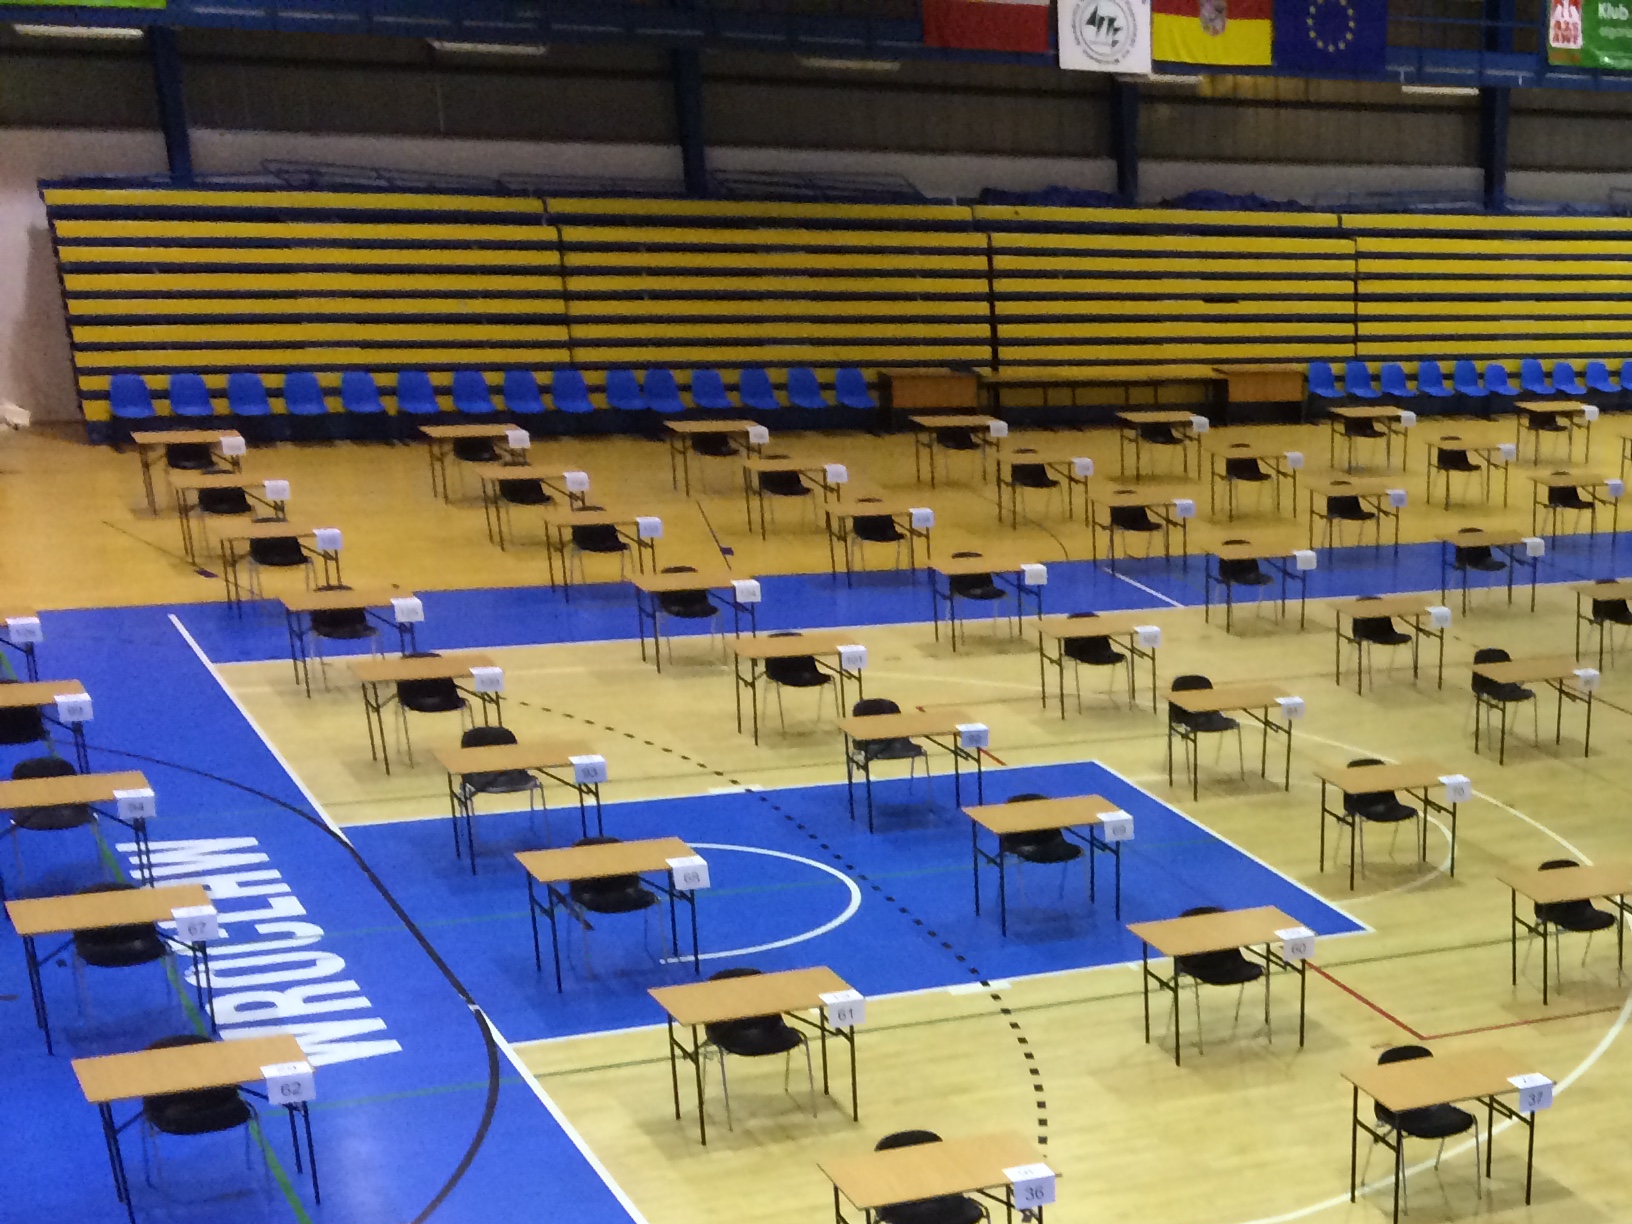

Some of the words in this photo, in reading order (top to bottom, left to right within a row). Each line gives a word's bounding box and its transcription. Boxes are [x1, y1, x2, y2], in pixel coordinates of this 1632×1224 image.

[837, 1008, 854, 1021] 61
[280, 1081, 301, 1097] 62
[1528, 1091, 1544, 1107] 37
[1025, 1185, 1044, 1201] 36
